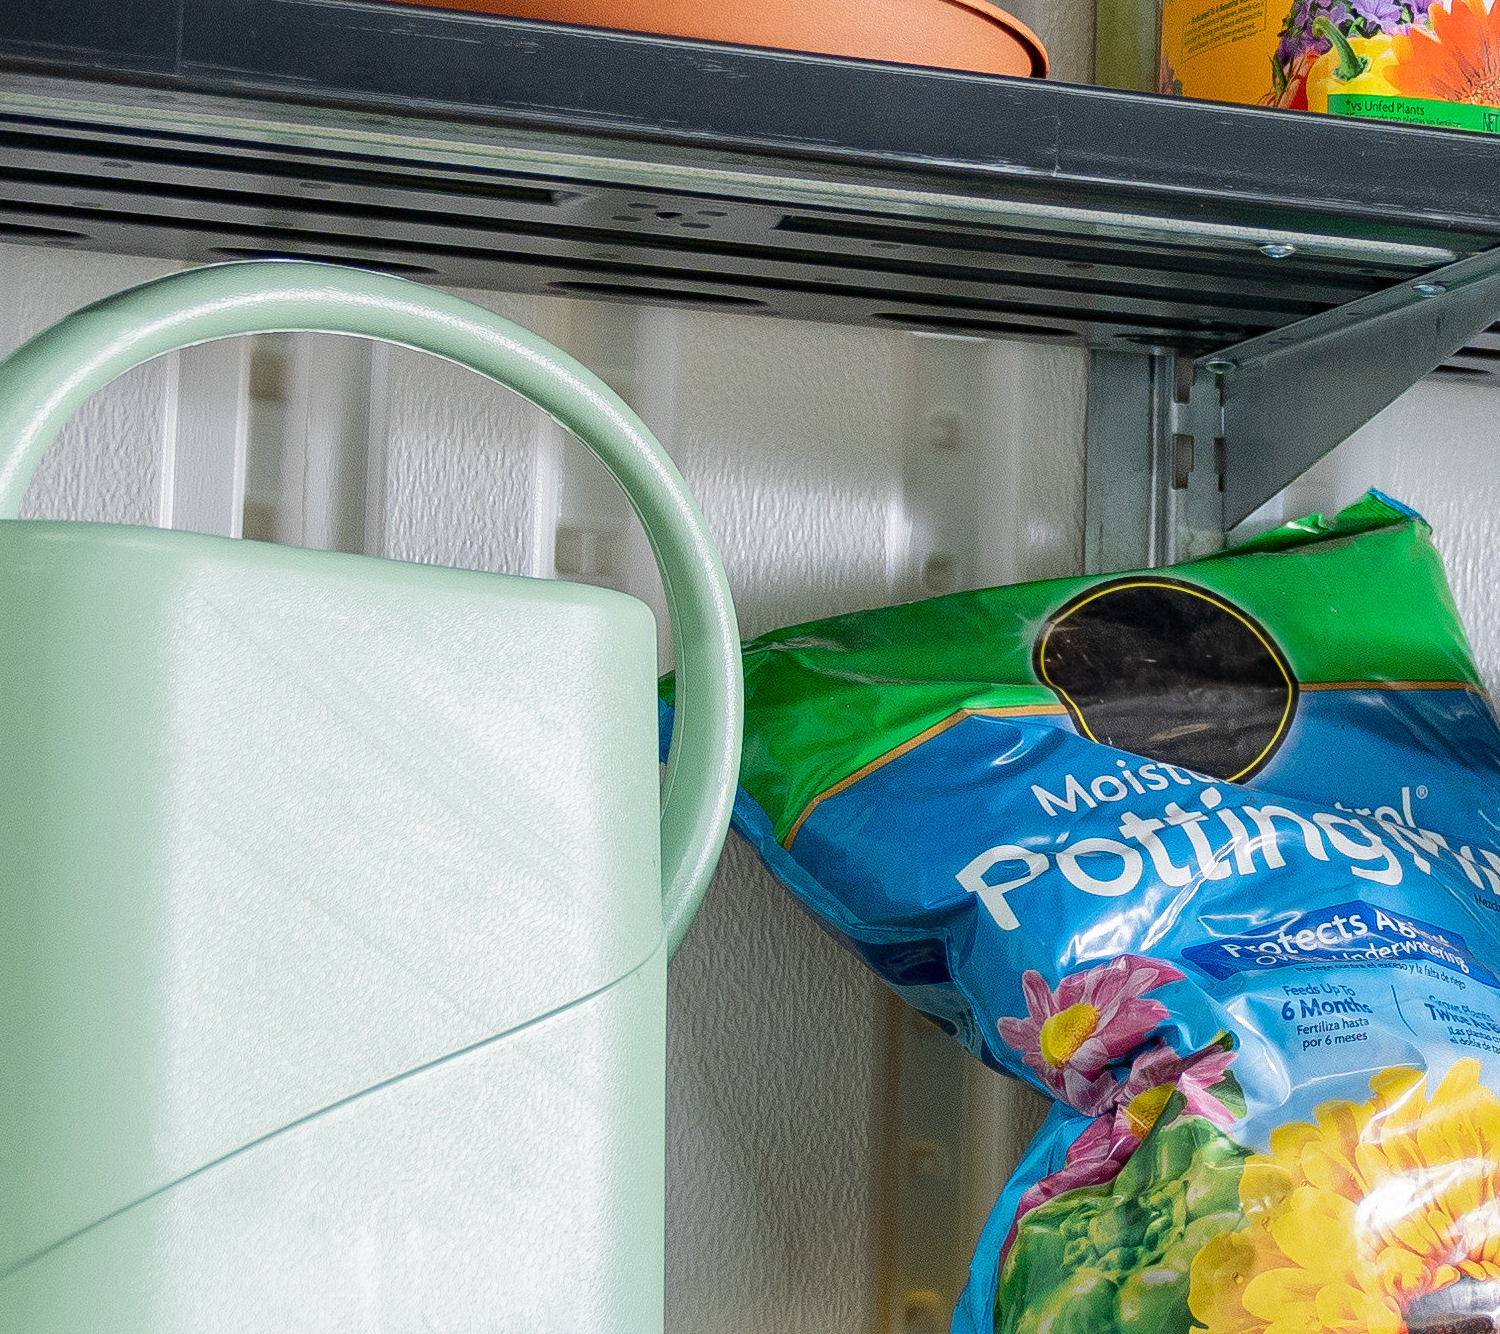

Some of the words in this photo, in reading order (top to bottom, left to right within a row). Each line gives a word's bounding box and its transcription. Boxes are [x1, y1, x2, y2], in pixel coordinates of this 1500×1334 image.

[1364, 100, 1395, 113] Unfed
[1397, 102, 1425, 116] Plants
[1483, 112, 1499, 133] NET
[954, 786, 1403, 932] Potting
[1221, 913, 1368, 958] Protects
[1282, 984, 1320, 997] Feeds
[1320, 982, 1338, 997] Up
[1339, 984, 1356, 997] To
[1281, 1000, 1296, 1021] 6
[1299, 996, 1374, 1019] Months
[1423, 1002, 1472, 1026] Twice
[1296, 1020, 1340, 1036] Fertiliza
[1342, 1017, 1370, 1030] hasta
[1302, 1038, 1322, 1051] por
[1325, 1034, 1332, 1046] 6
[1334, 1032, 1368, 1045] meses
